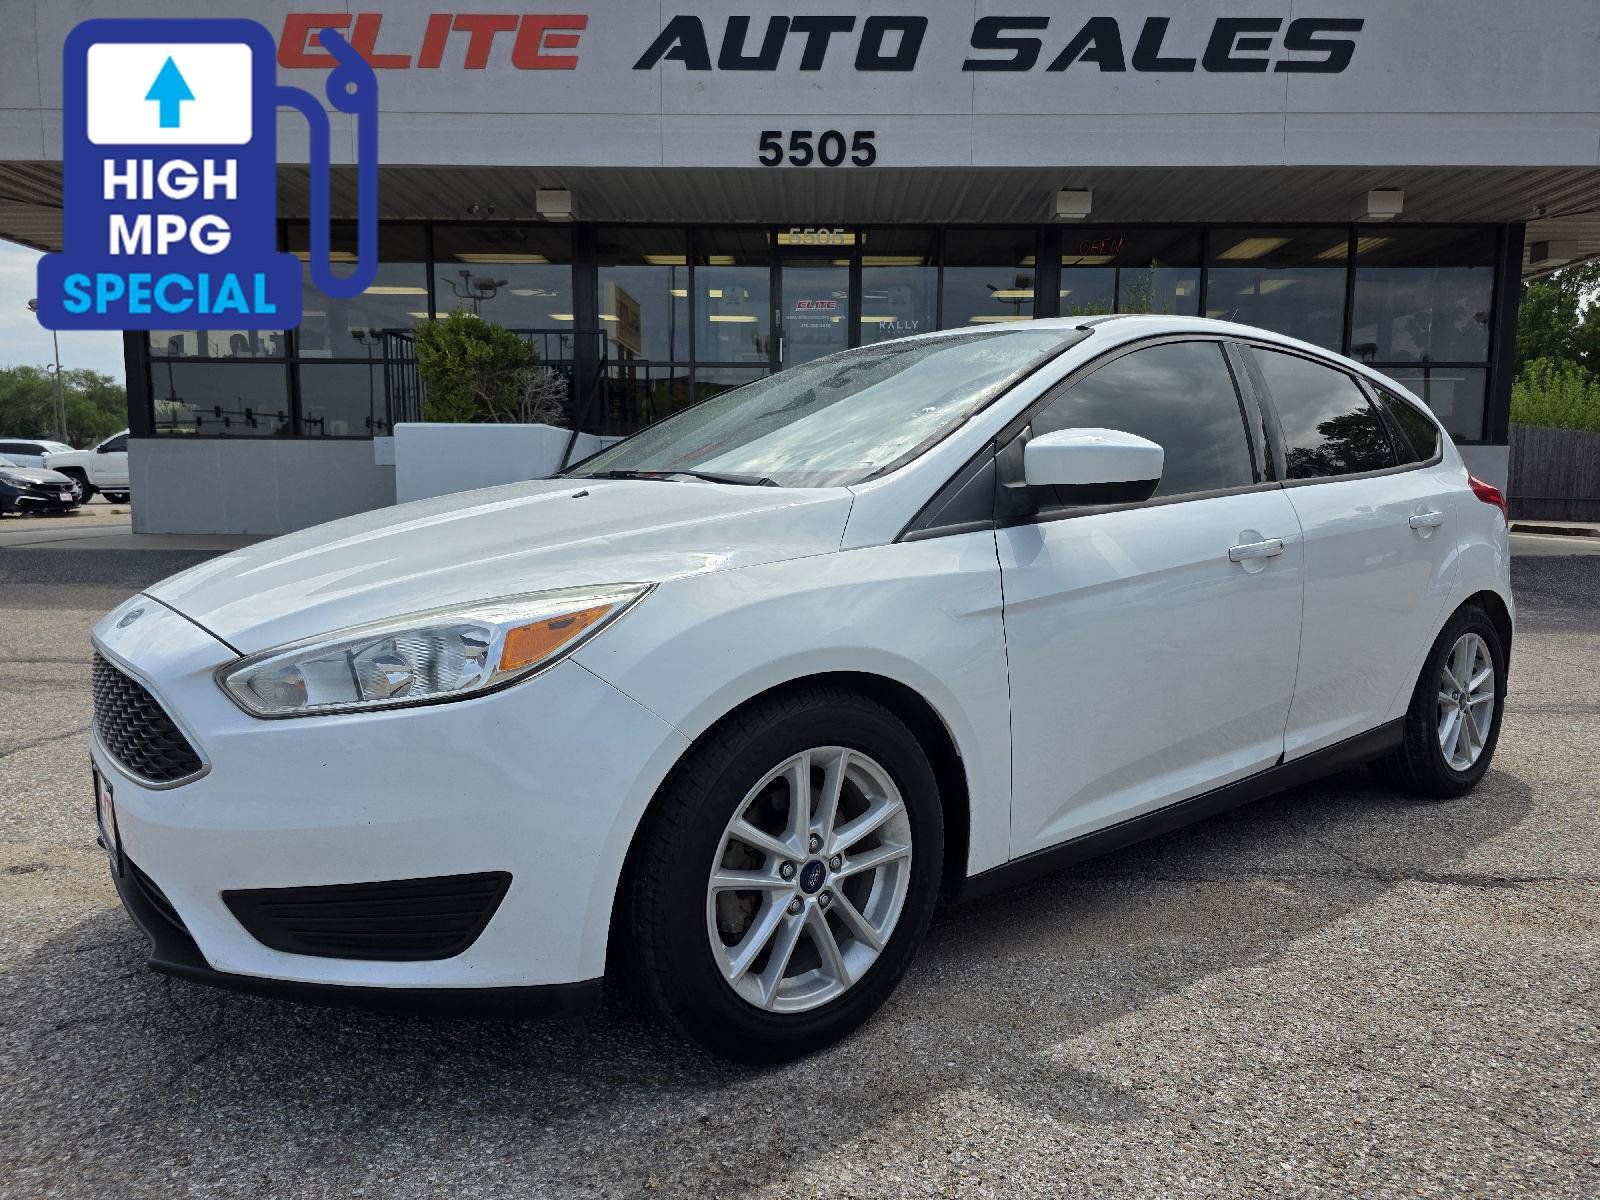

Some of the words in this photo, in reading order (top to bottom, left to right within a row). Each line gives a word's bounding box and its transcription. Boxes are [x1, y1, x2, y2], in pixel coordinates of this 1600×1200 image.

[277, 13, 588, 70] ELITE
[632, 15, 928, 71] AUTO
[962, 16, 1364, 73] SALES
[758, 129, 877, 167] 5505
[789, 228, 845, 245] 5505
[879, 320, 919, 329] RALLY
